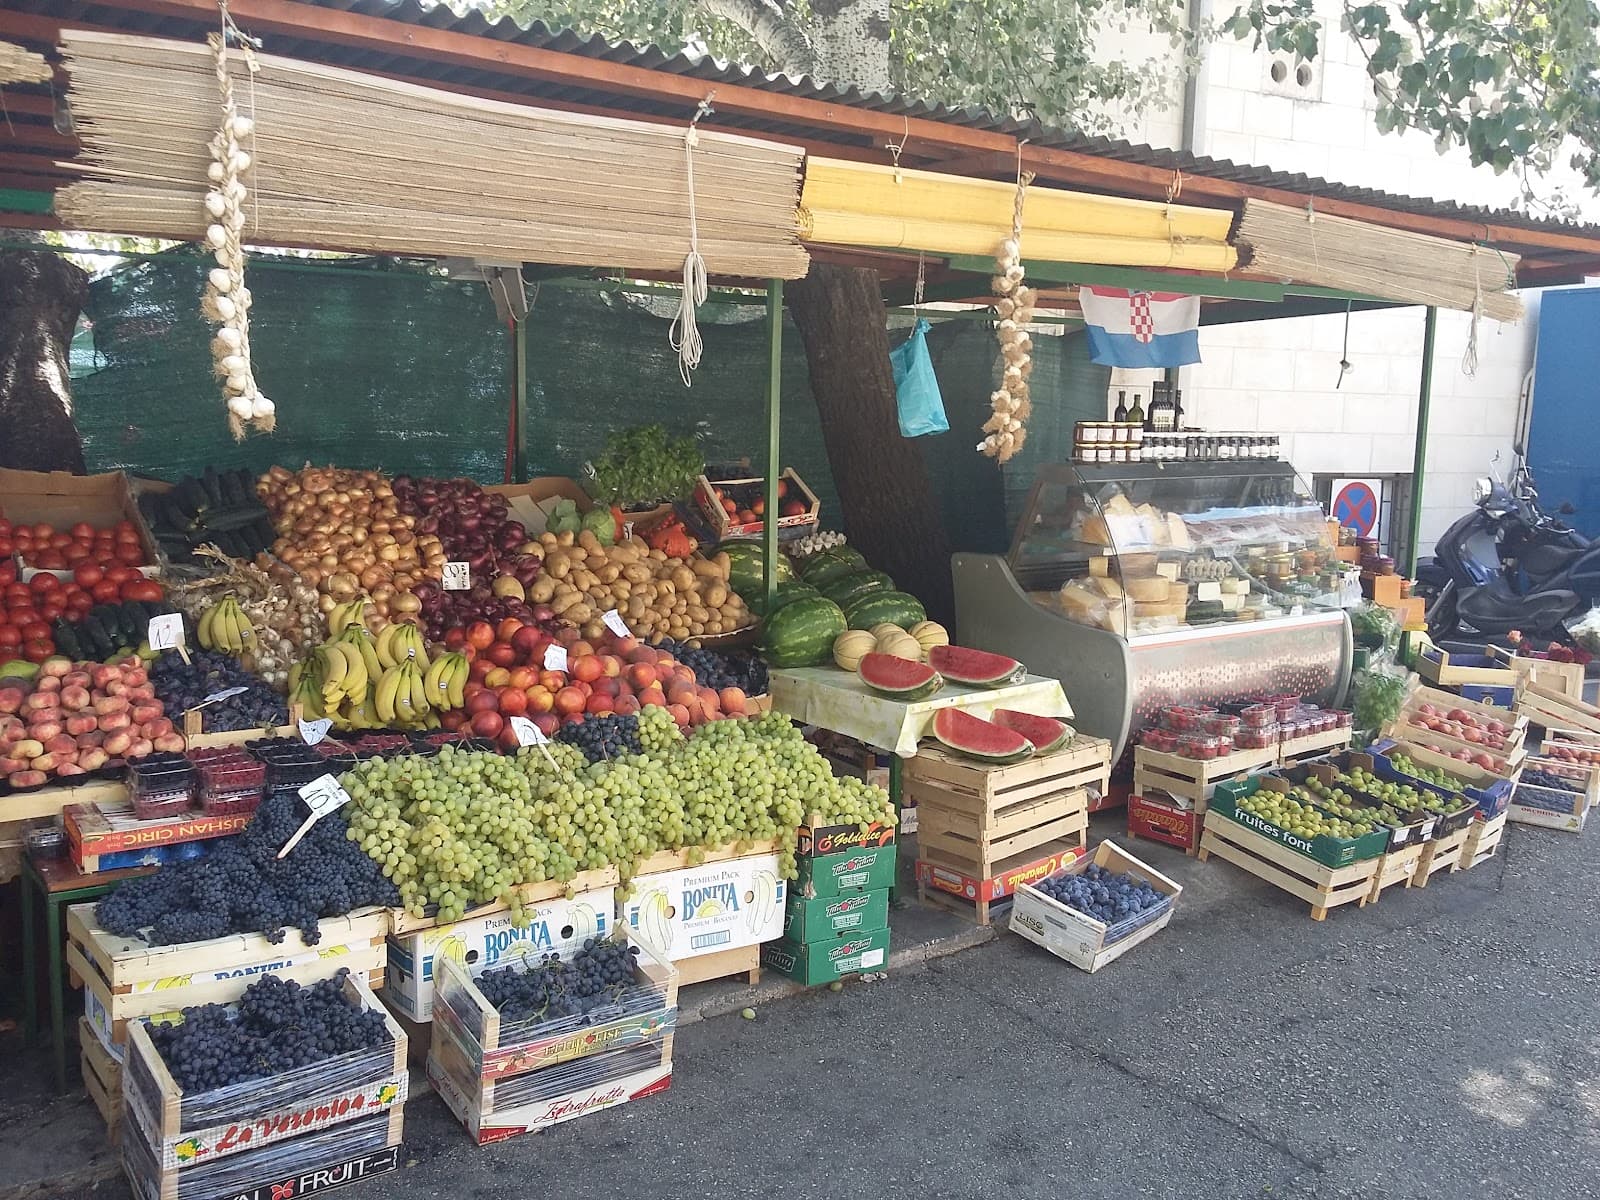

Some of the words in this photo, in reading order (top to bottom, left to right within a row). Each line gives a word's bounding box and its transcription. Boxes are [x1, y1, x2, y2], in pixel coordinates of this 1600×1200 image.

[305, 788, 330, 810] 10
[1234, 808, 1279, 837] fruites
[1282, 831, 1313, 854] font
[721, 871, 740, 881] PACK
[485, 917, 511, 930] PREM
[536, 907, 553, 918] ACK
[681, 882, 740, 921] BONITA
[484, 920, 555, 966] BONITA
[299, 1156, 372, 1194] FRUIT
